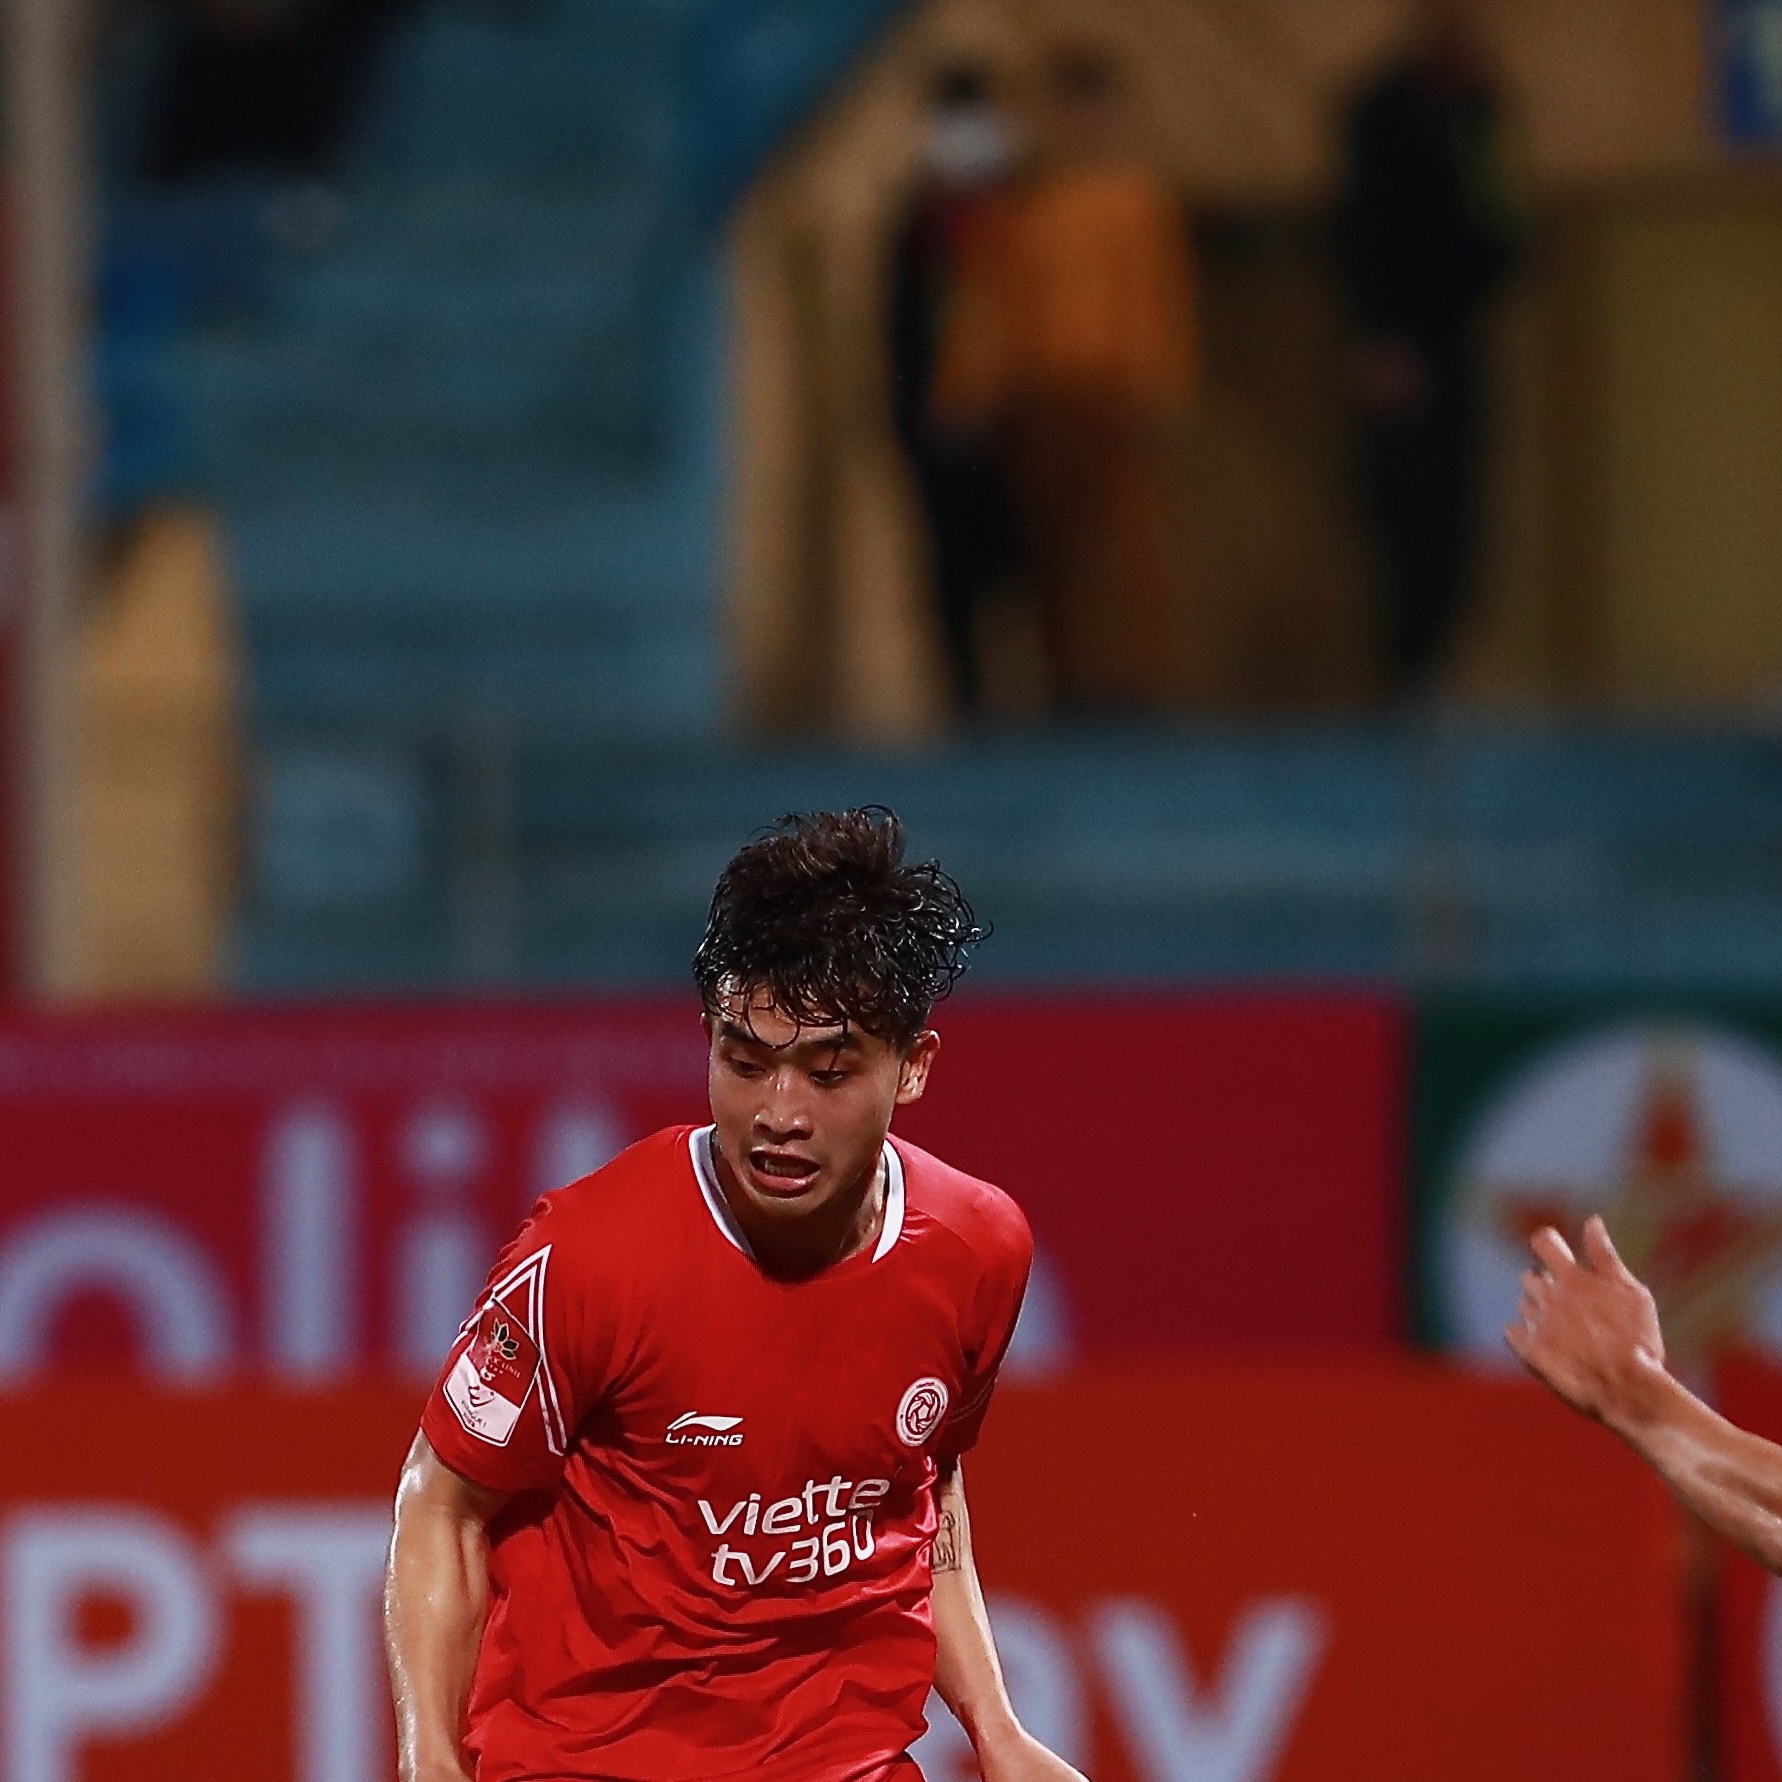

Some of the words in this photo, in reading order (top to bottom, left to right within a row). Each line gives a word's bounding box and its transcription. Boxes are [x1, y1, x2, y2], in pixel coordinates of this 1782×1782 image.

[665, 1432, 744, 1446] LI-NING
[697, 1475, 891, 1536] viette
[710, 1509, 875, 1587] tv360
